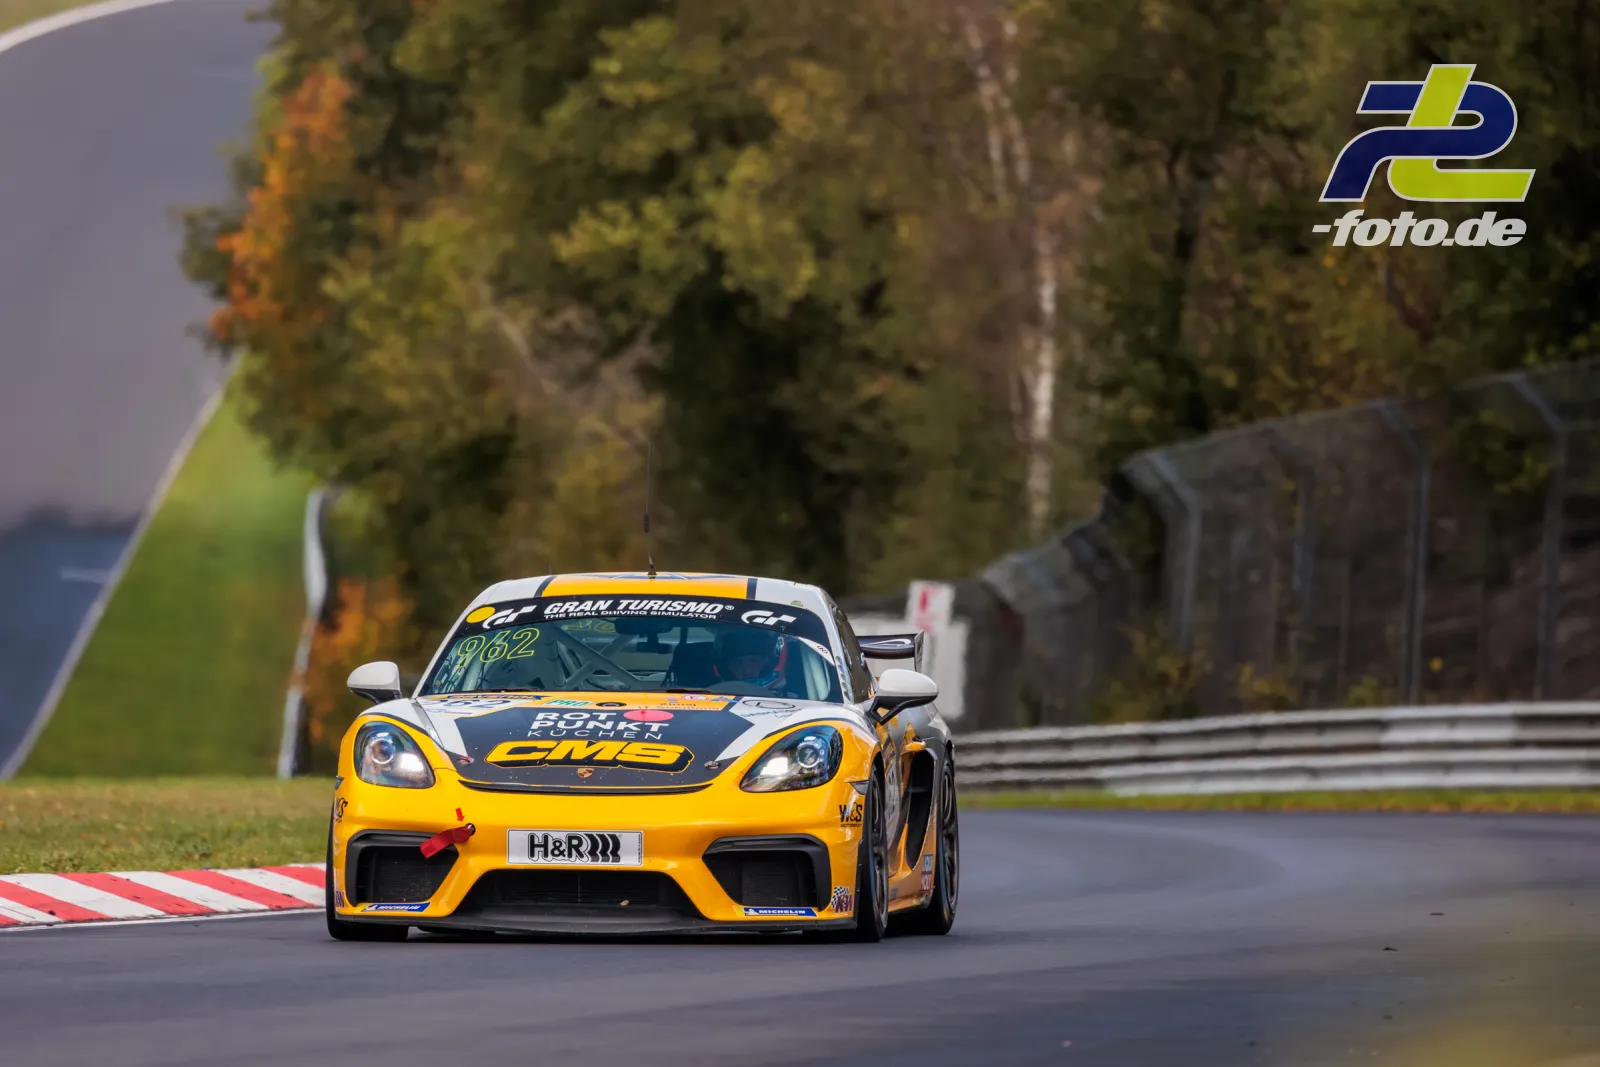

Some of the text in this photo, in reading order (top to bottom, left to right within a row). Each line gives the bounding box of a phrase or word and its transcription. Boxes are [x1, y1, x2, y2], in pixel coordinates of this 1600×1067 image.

[544, 600, 613, 614] GRAN
[650, 610, 717, 619] SIMULATOR
[457, 627, 540, 668] 962
[535, 712, 617, 721] ROT
[530, 720, 670, 732] PUNKT
[527, 728, 662, 740] KÜCHEN
[485, 740, 685, 765] CMS
[528, 833, 589, 862] H&R
